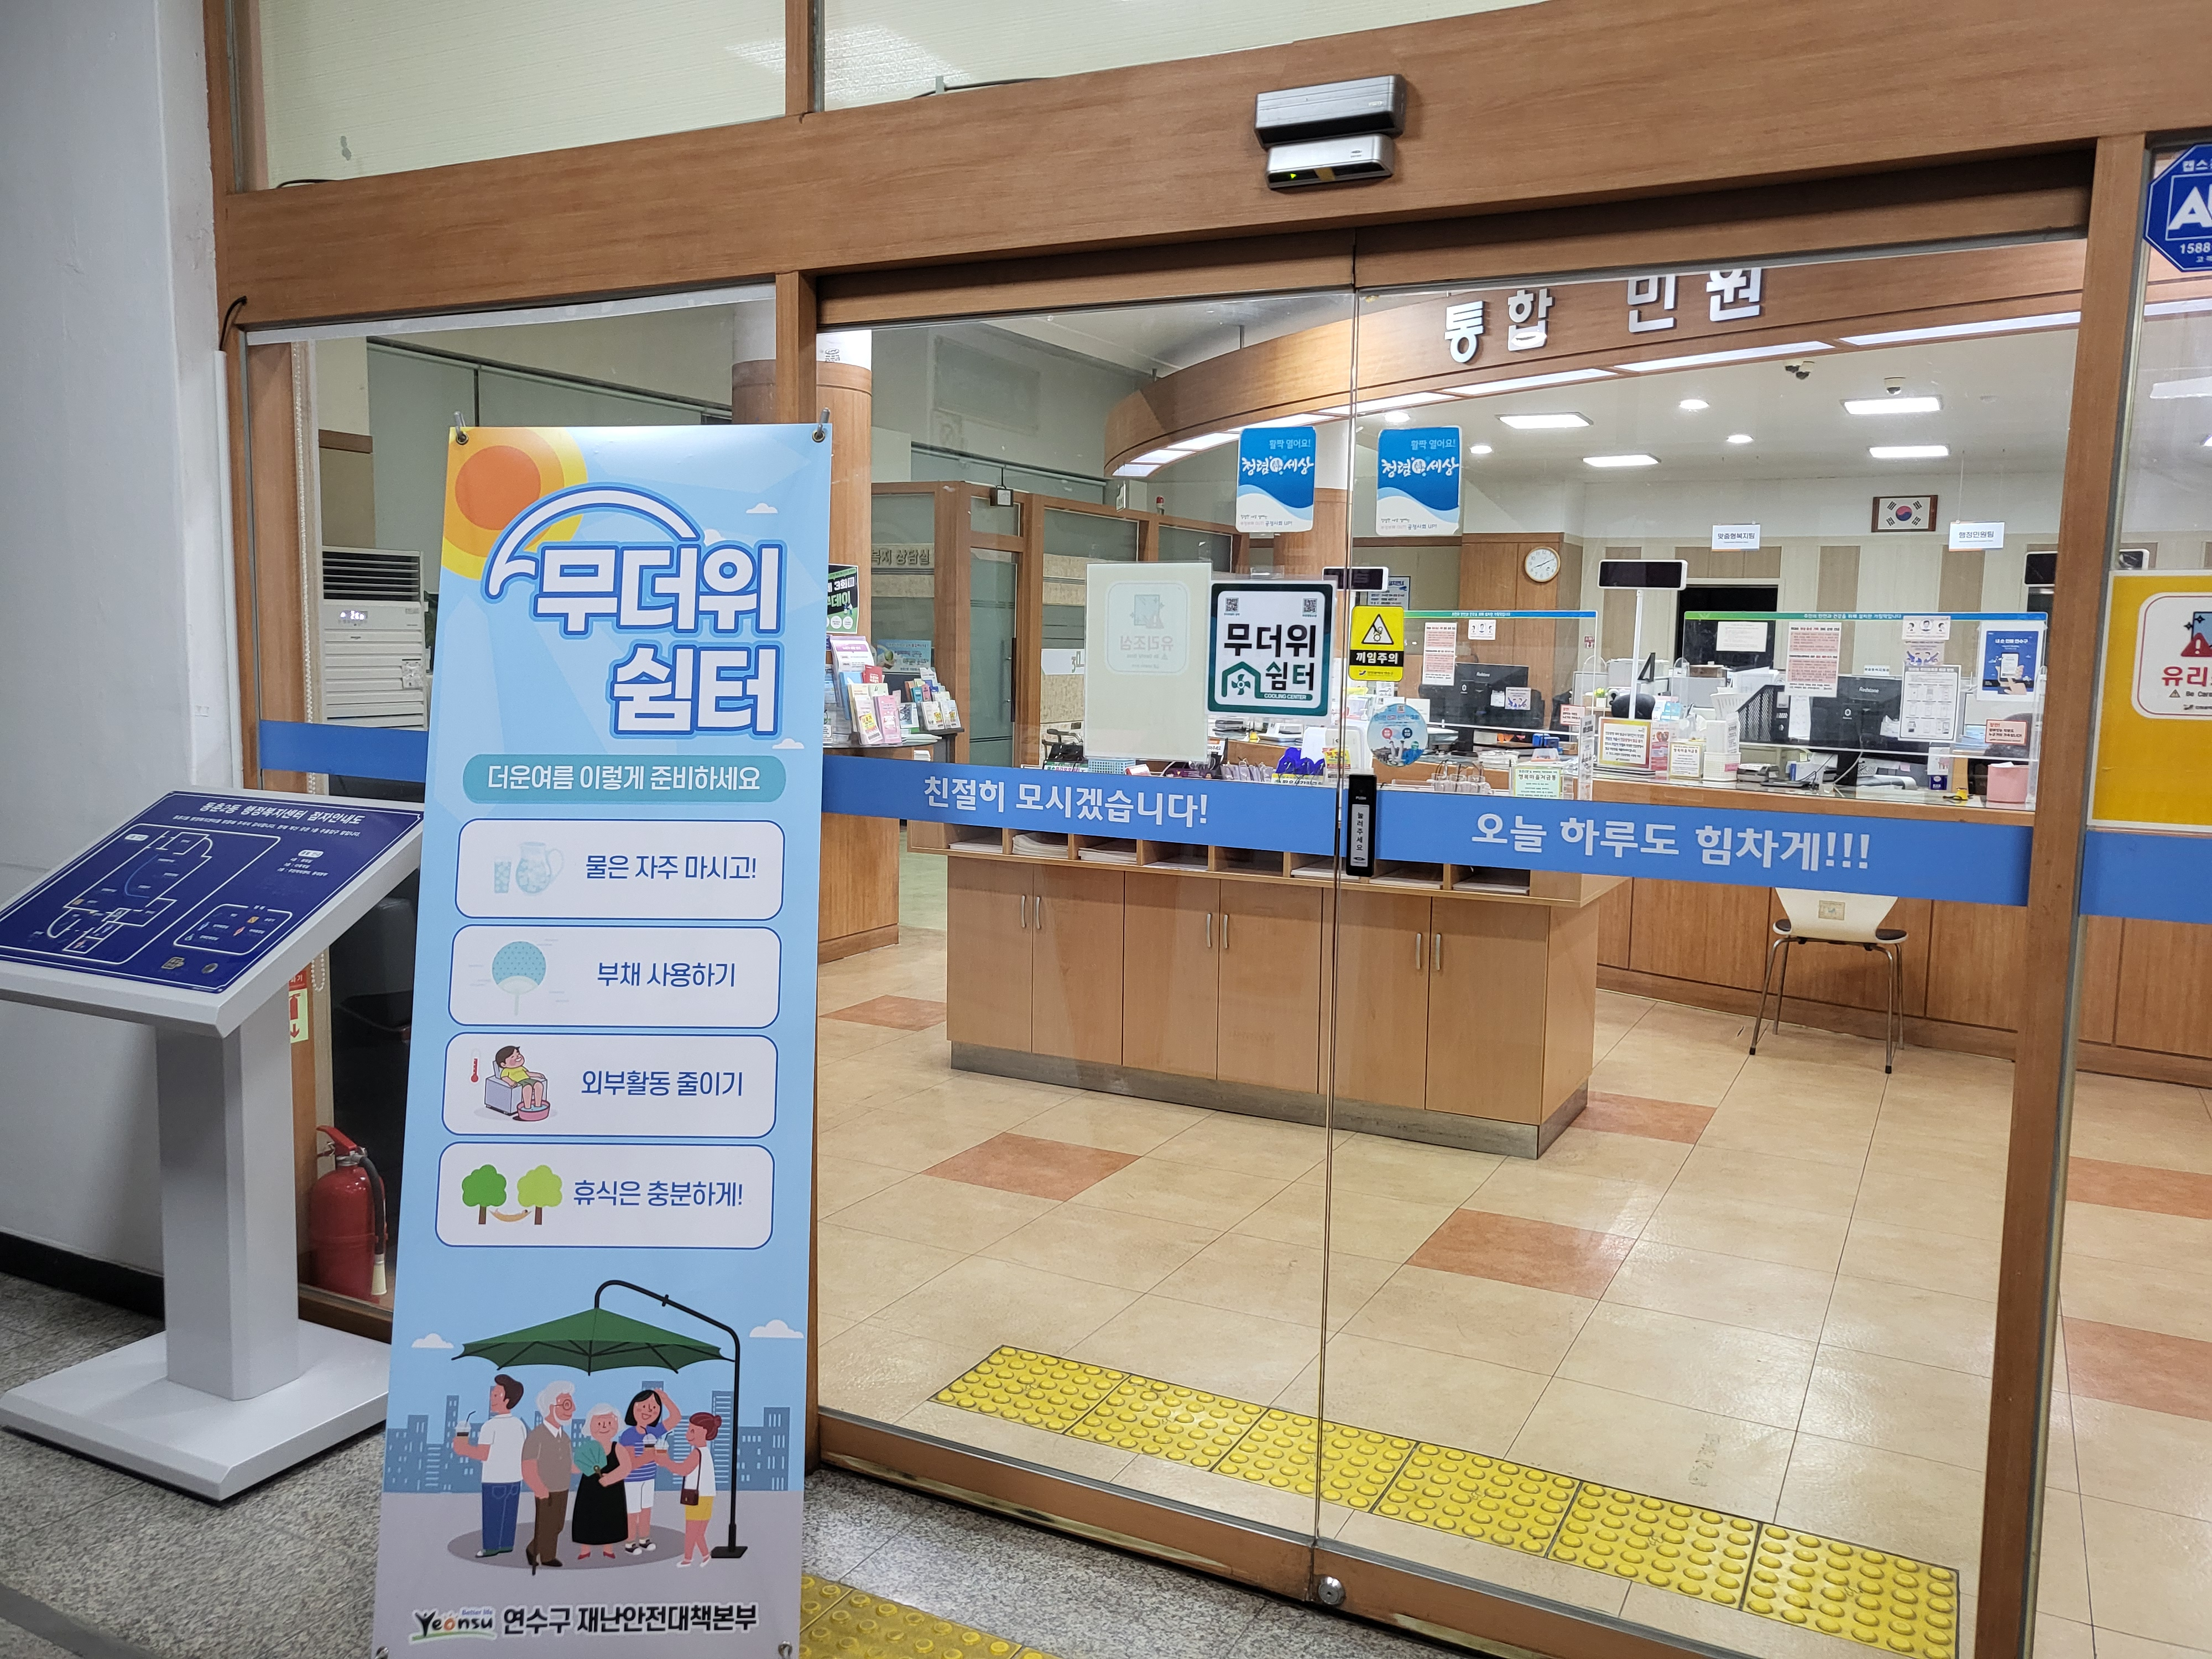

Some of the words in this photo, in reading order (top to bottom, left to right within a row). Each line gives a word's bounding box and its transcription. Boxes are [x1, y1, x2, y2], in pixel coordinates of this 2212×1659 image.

[2168, 184, 2212, 230] A
[2179, 242, 2212, 254] 1588
[1444, 288, 1554, 363] 통합
[1286, 439, 1311, 449] 열어요!
[1429, 439, 1455, 450] 열어요!
[896, 549, 930, 565] 상담실
[534, 545, 782, 633] 무더위
[834, 578, 848, 591] 3회
[1224, 623, 1316, 658] 무더위
[1355, 651, 1400, 665] 끼임주의
[1266, 661, 1314, 691] 쉼터
[2162, 666, 2212, 687] 유리
[613, 646, 779, 733] 쉼터
[488, 765, 574, 790] 더운여름
[580, 765, 645, 790] 이렇게
[650, 766, 760, 791] 준비하세요
[199, 802, 242, 814] 동춘2동
[241, 804, 308, 820] 행정복지센터
[307, 811, 366, 825] 점자안내도
[924, 775, 1005, 813] 친절히
[1015, 782, 1208, 828] 모시겠습니다!
[1471, 813, 1547, 854] 오늘
[1560, 817, 1679, 857] 하루도
[1695, 826, 1870, 872] 힘차게!!!
[586, 855, 629, 879] 물은
[635, 856, 679, 879] 자주
[685, 855, 757, 880] 마시고!
[597, 962, 641, 987] 부채
[646, 962, 735, 987] 사용하기
[581, 1071, 670, 1096] 외부활동
[676, 1071, 743, 1097] 줄이기
[573, 1180, 641, 1206] 휴식은
[647, 1181, 743, 1207] 충분하게!
[415, 1610, 493, 1637] Yeonsu
[503, 1608, 571, 1635] 연수구
[577, 1603, 758, 1633] 재난안전대책본부
